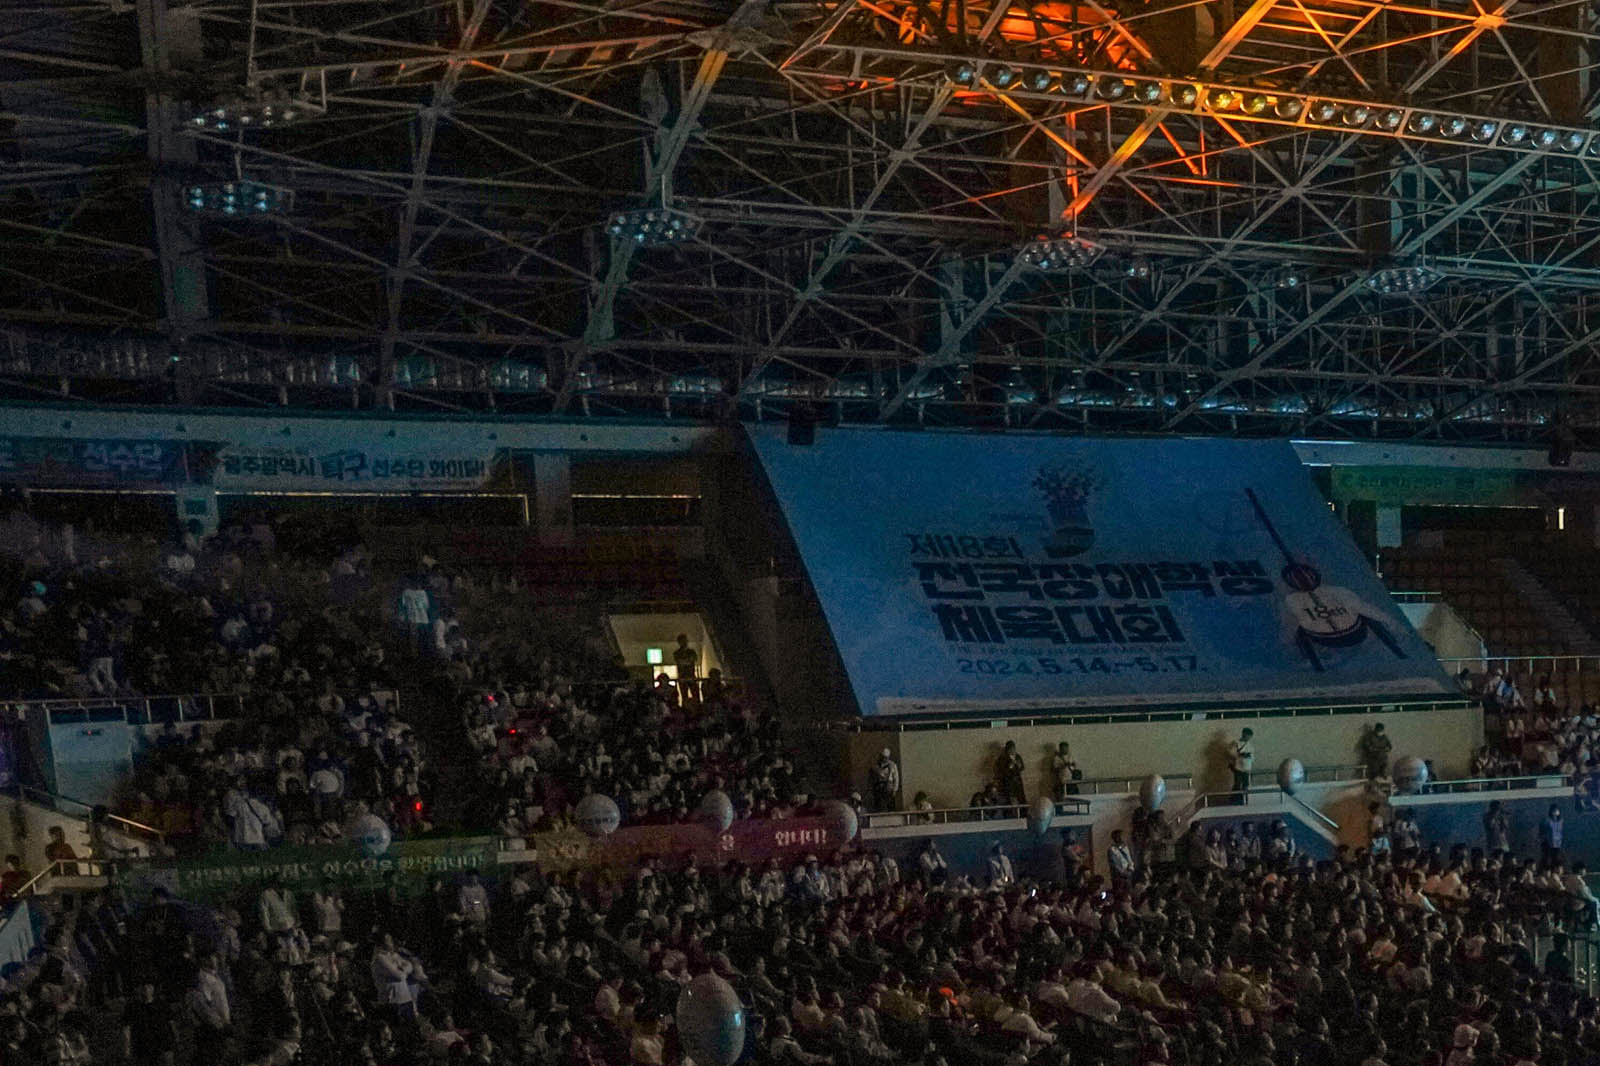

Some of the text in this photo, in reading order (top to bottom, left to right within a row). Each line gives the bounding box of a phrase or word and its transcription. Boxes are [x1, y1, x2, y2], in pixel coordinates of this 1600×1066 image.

[906, 533, 1024, 560] 제18회
[912, 559, 1275, 601] 전국장애학생
[932, 603, 1187, 645] 체육대회
